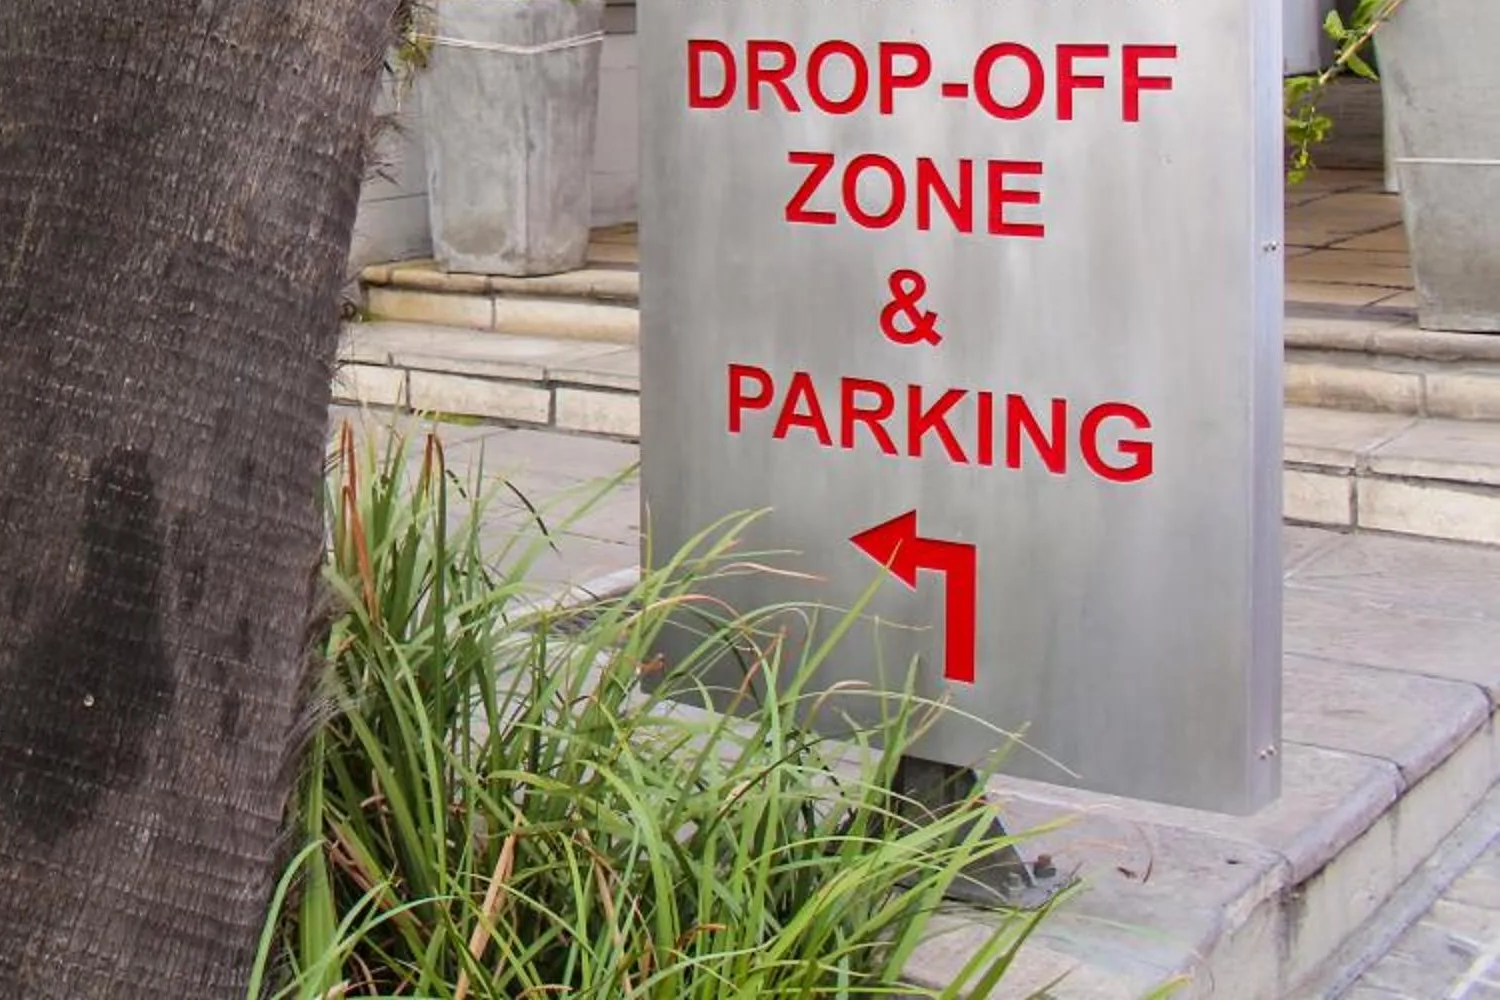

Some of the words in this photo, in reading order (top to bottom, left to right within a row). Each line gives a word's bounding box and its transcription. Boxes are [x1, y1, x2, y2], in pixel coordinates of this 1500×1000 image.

[687, 40, 1178, 122] DROP-OFF
[785, 151, 1045, 238] ZONE
[879, 269, 942, 347] &
[728, 363, 1154, 482] PARKING
